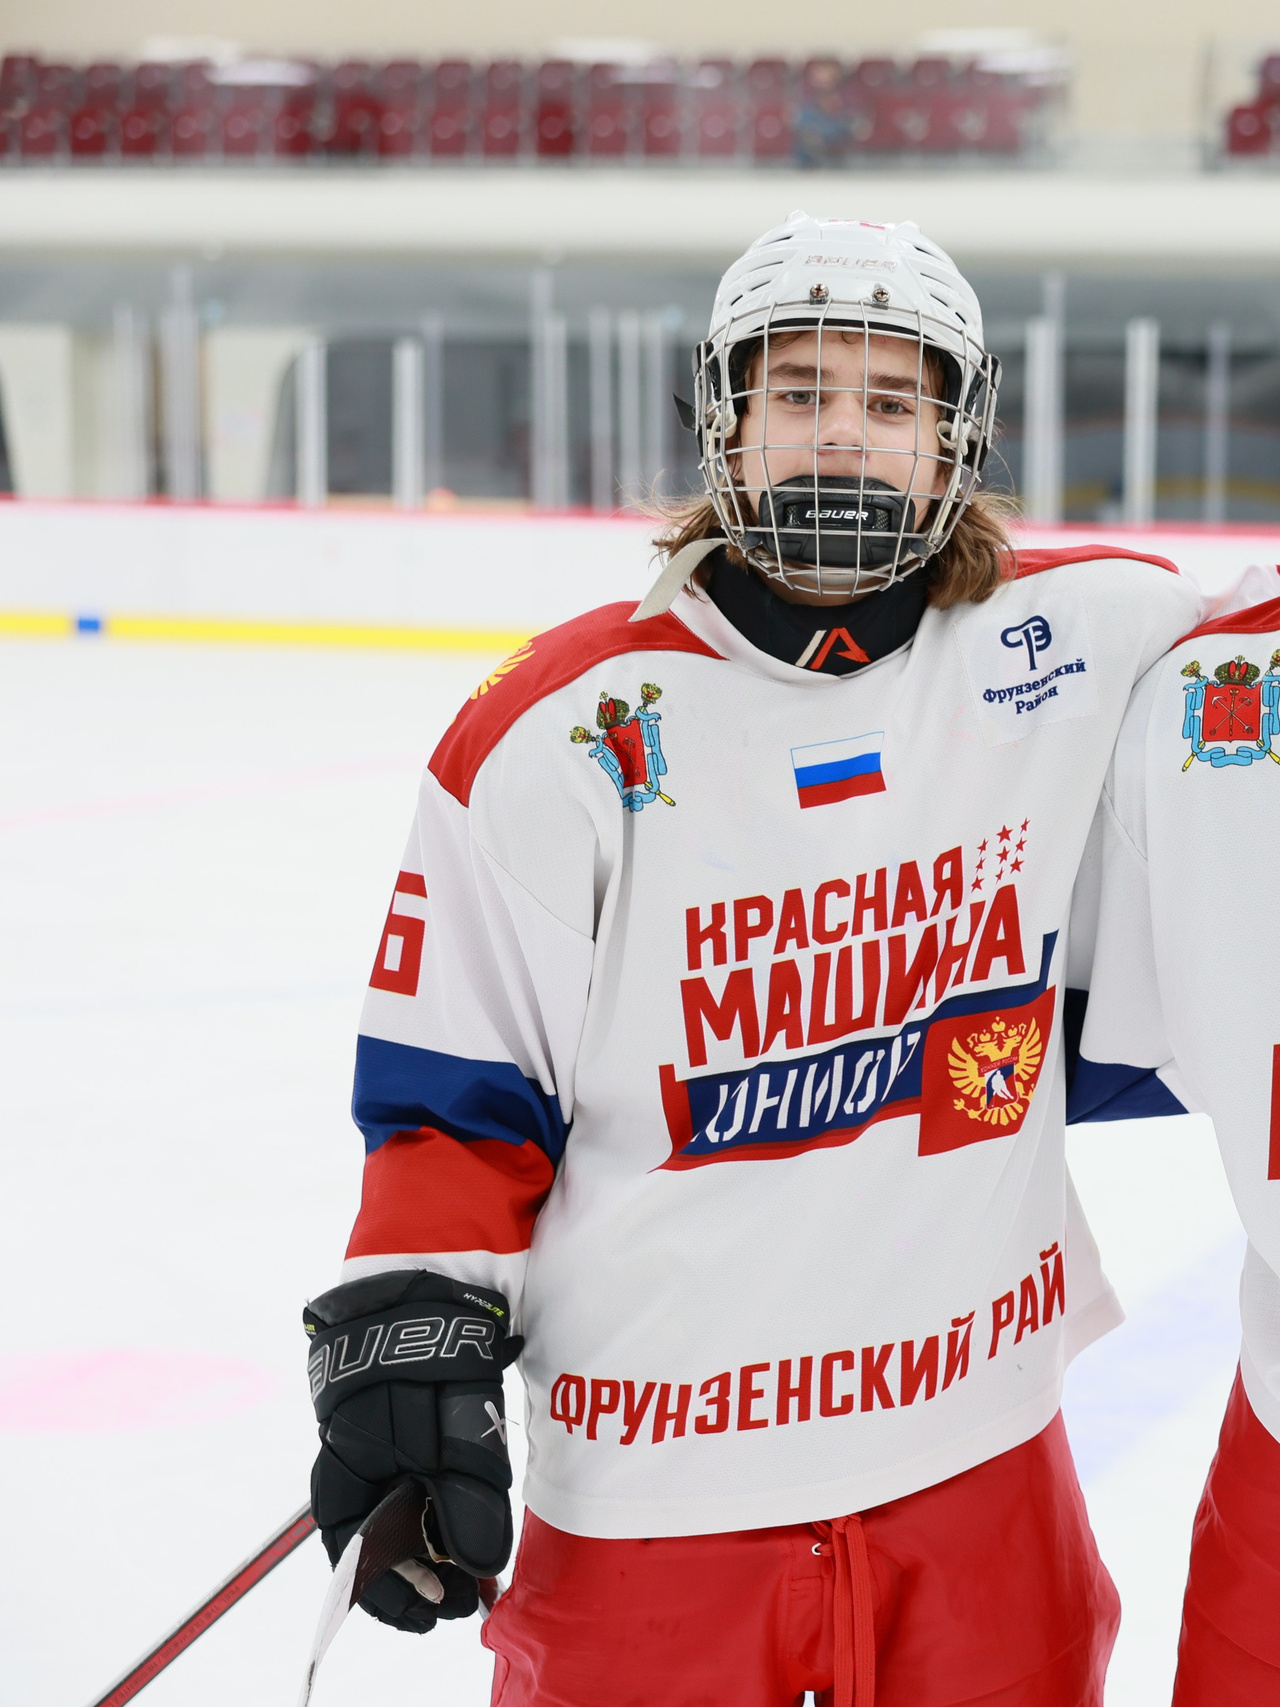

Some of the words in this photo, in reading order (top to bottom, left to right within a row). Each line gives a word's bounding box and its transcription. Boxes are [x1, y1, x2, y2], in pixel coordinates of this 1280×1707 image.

[805, 509, 869, 521] BAUER
[983, 658, 1086, 703] Фрунзенский
[1015, 685, 1058, 714] Район
[685, 846, 963, 971] КРАСНАЯ
[680, 884, 1026, 1068] МАШИНА
[549, 1310, 976, 1446] ФРУНЗЕНСКИЙ
